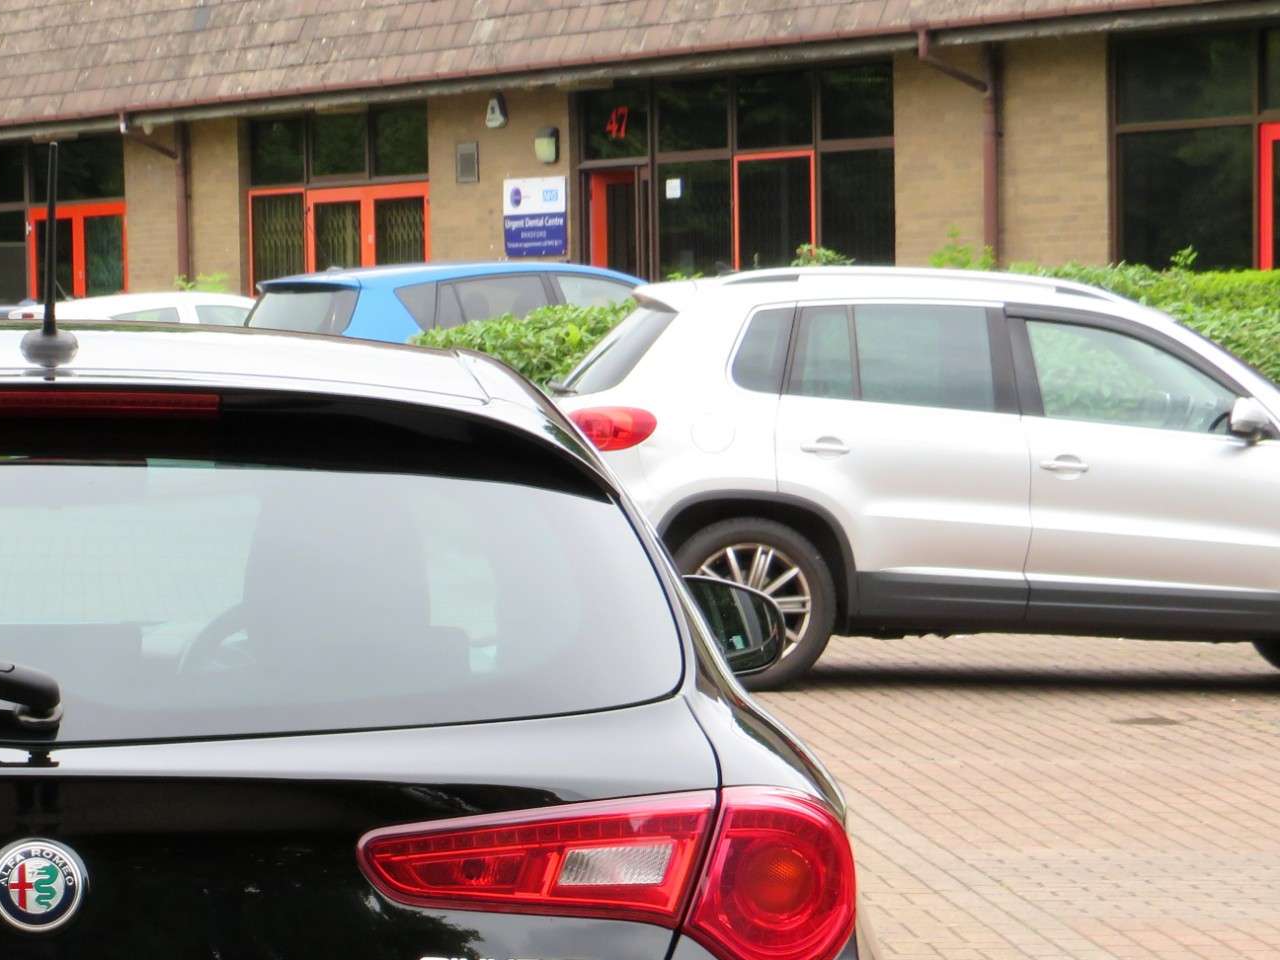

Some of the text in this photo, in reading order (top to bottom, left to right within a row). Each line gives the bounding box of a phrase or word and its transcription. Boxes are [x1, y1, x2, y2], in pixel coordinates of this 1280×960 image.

[605, 106, 629, 139] 47
[505, 214, 564, 231] Urgent Dental Centre
[0, 848, 75, 887] ALFA ROMEO
